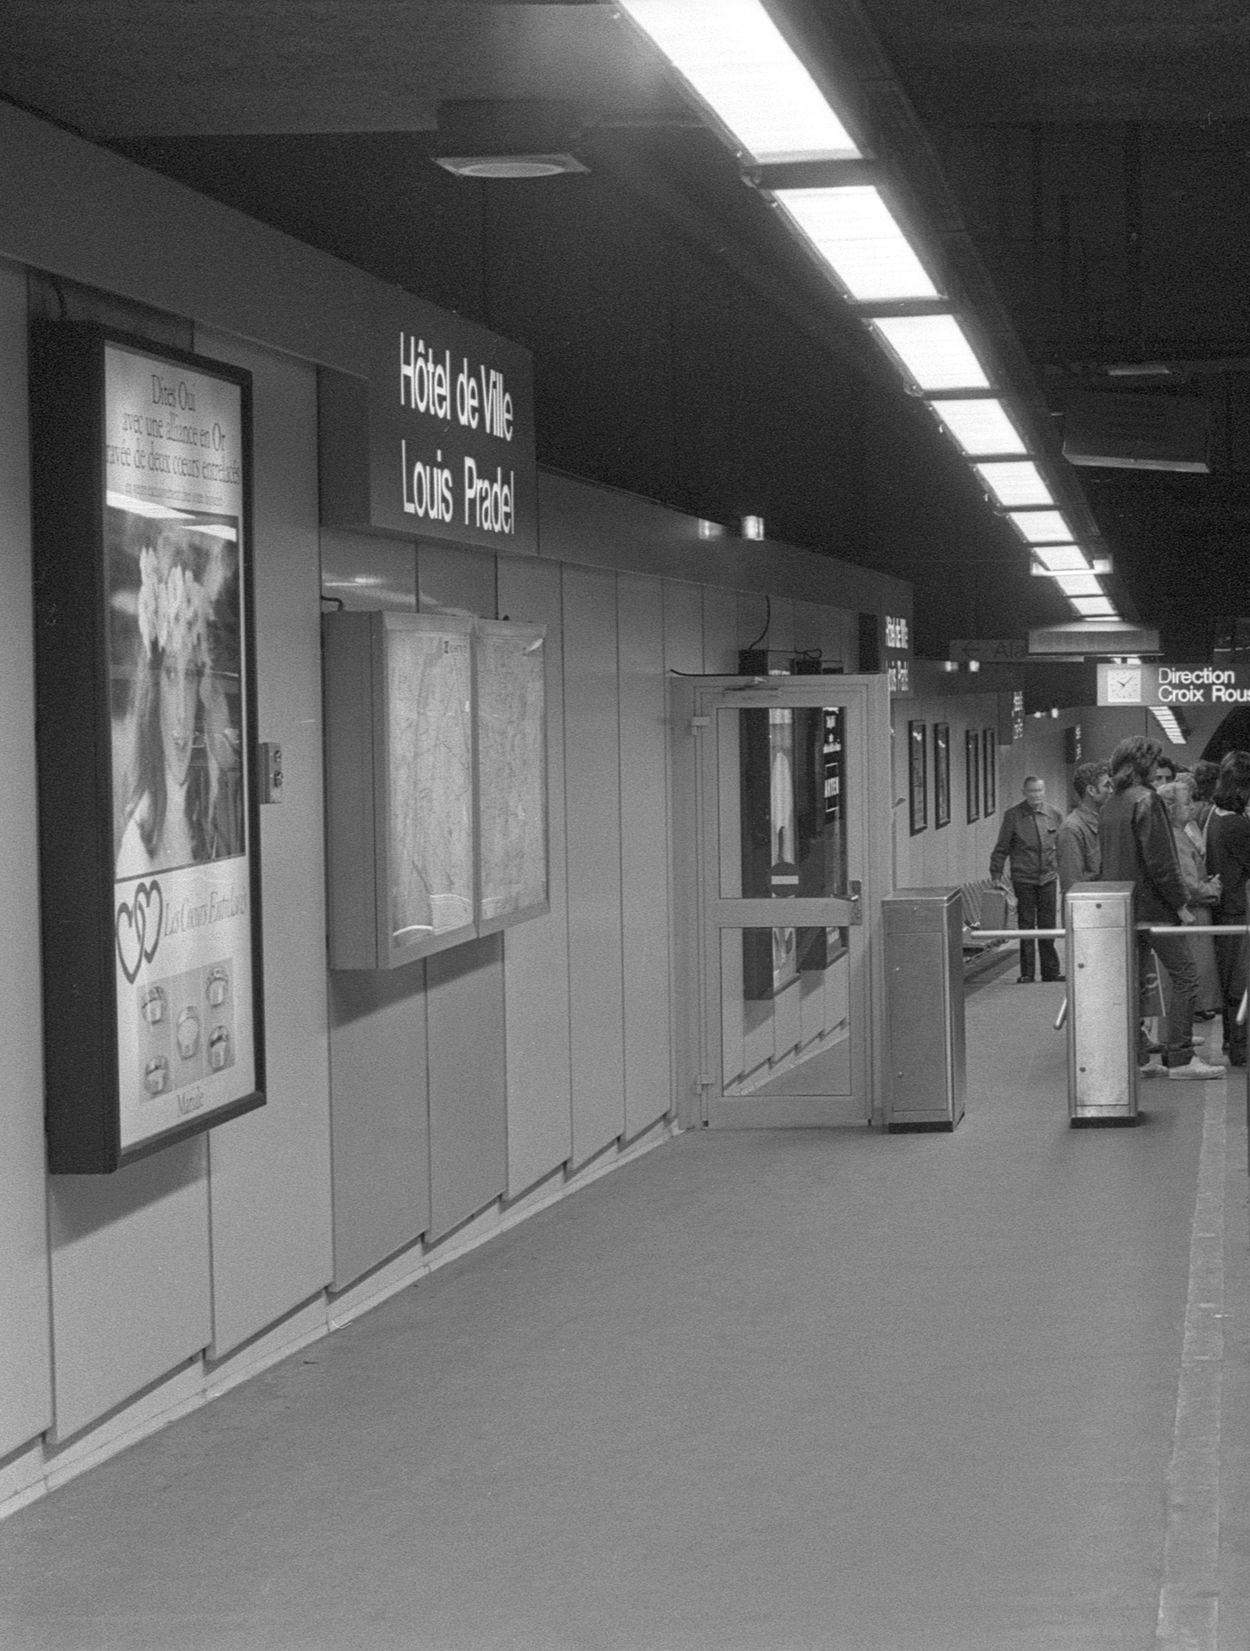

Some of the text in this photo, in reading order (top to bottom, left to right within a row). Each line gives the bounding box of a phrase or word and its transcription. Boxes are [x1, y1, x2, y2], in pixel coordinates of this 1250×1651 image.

[151, 374, 196, 412] Dites Oui
[400, 332, 513, 442] Hôtel de Ville
[146, 416, 164, 439] une
[213, 422, 226, 452] Or
[401, 439, 514, 535] Louis Pradel
[1158, 667, 1235, 685] Direction
[1158, 685, 1205, 703] Croix
